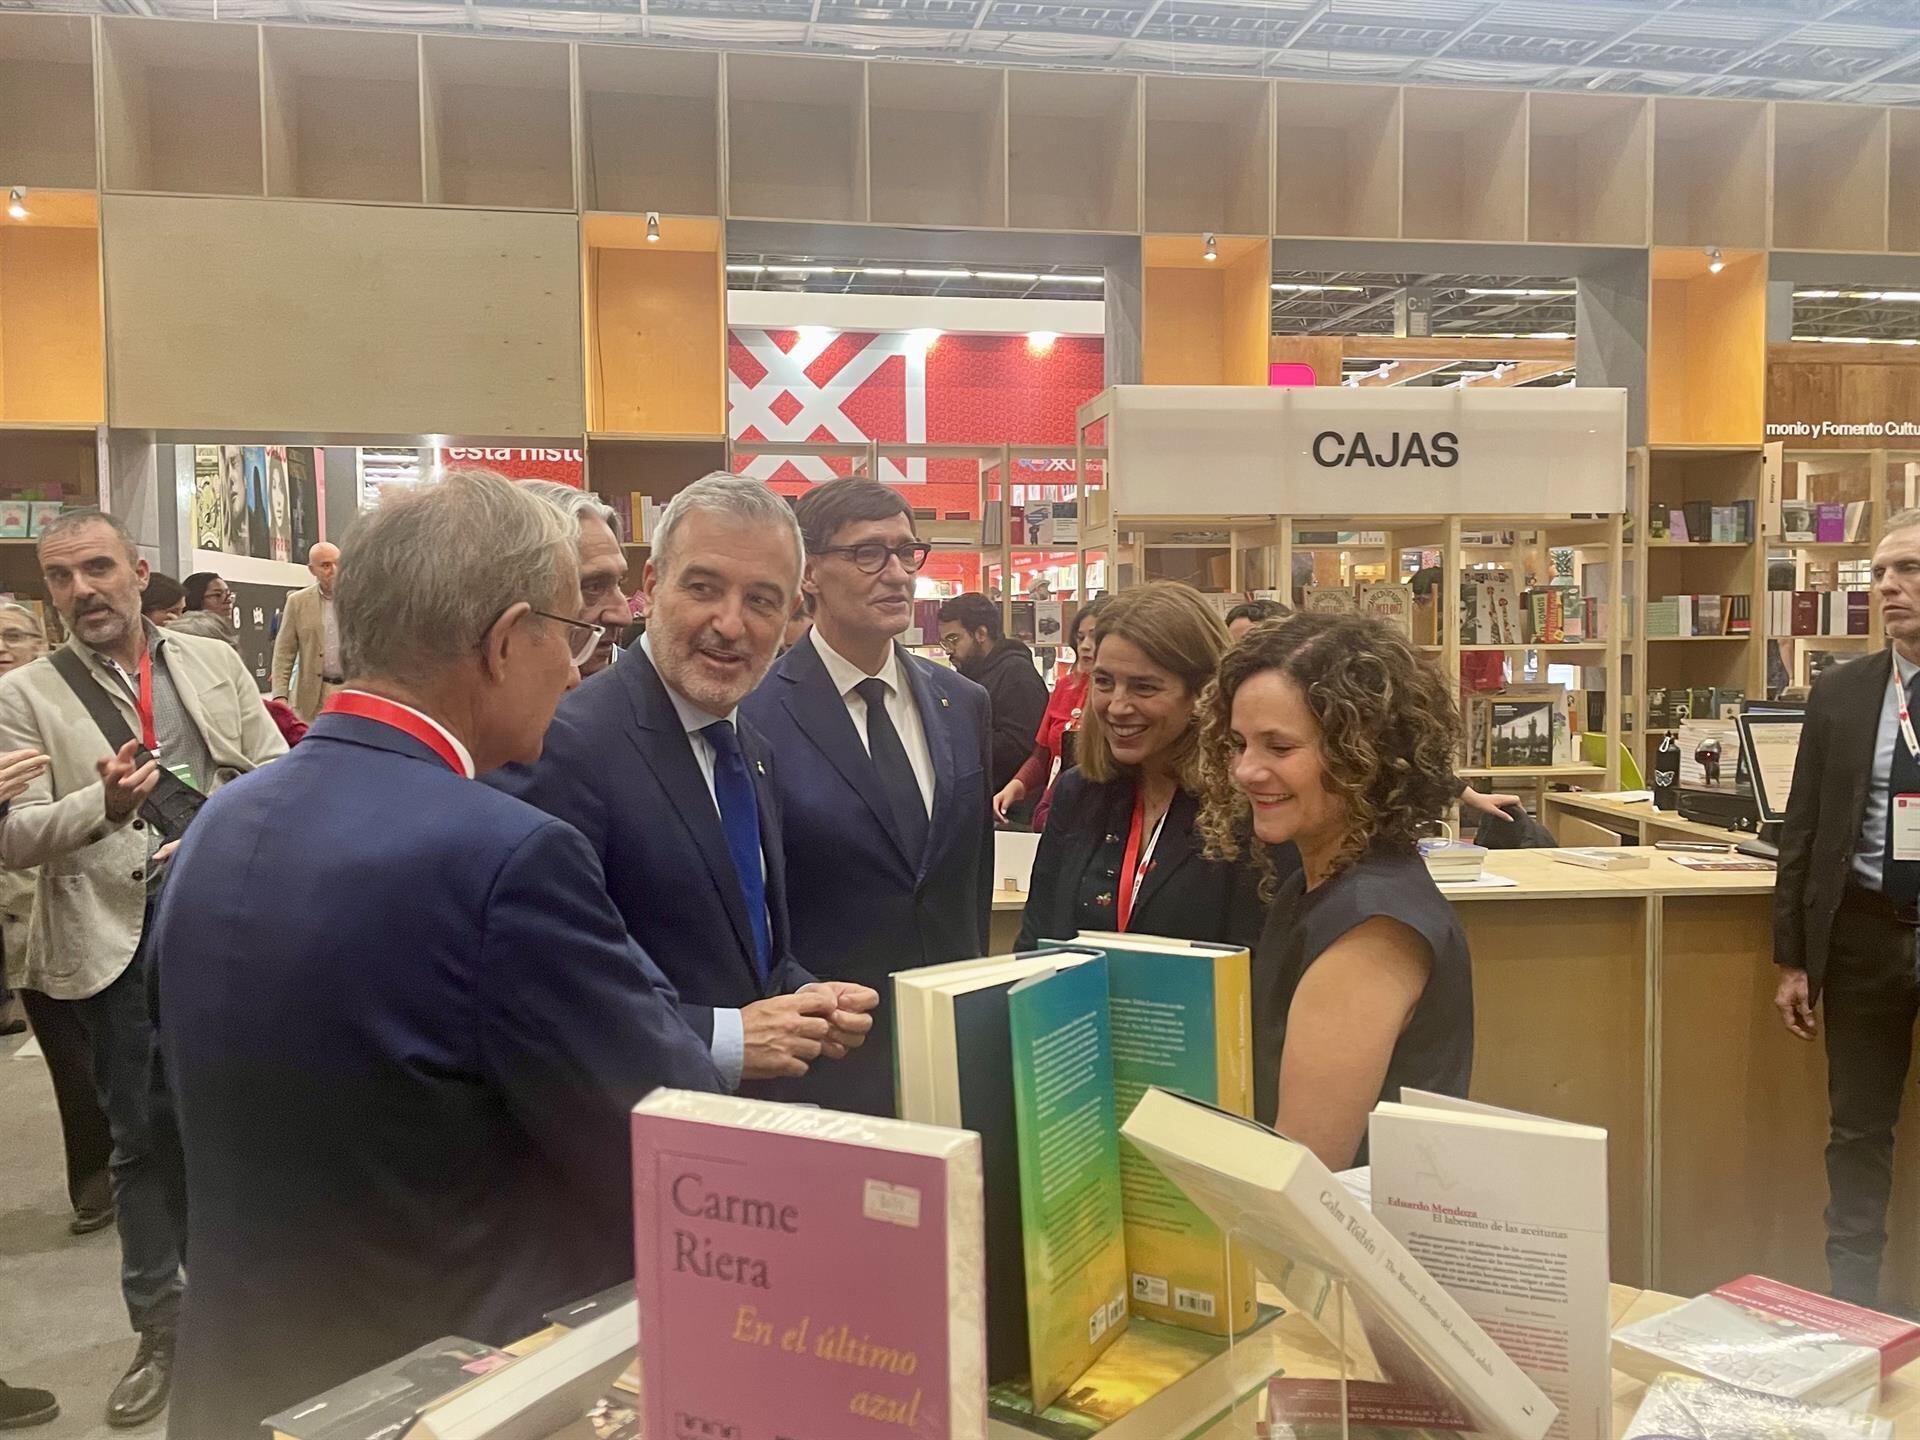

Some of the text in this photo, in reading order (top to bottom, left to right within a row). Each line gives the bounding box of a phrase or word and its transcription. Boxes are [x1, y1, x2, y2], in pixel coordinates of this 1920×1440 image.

[1312, 430, 1459, 468] CAJAS
[1766, 421, 1810, 436] monio
[1811, 424, 1821, 439] y
[1822, 421, 1883, 436] Fomento
[448, 447, 511, 461] esta
[671, 1172, 800, 1234] Carme
[1387, 1197, 1478, 1218] Eduardo Mendoza
[1433, 1213, 1568, 1240] El laberinto de las aceitunas
[672, 1229, 771, 1290] Riera
[732, 1304, 919, 1377] En el último
[848, 1386, 923, 1427] azul
